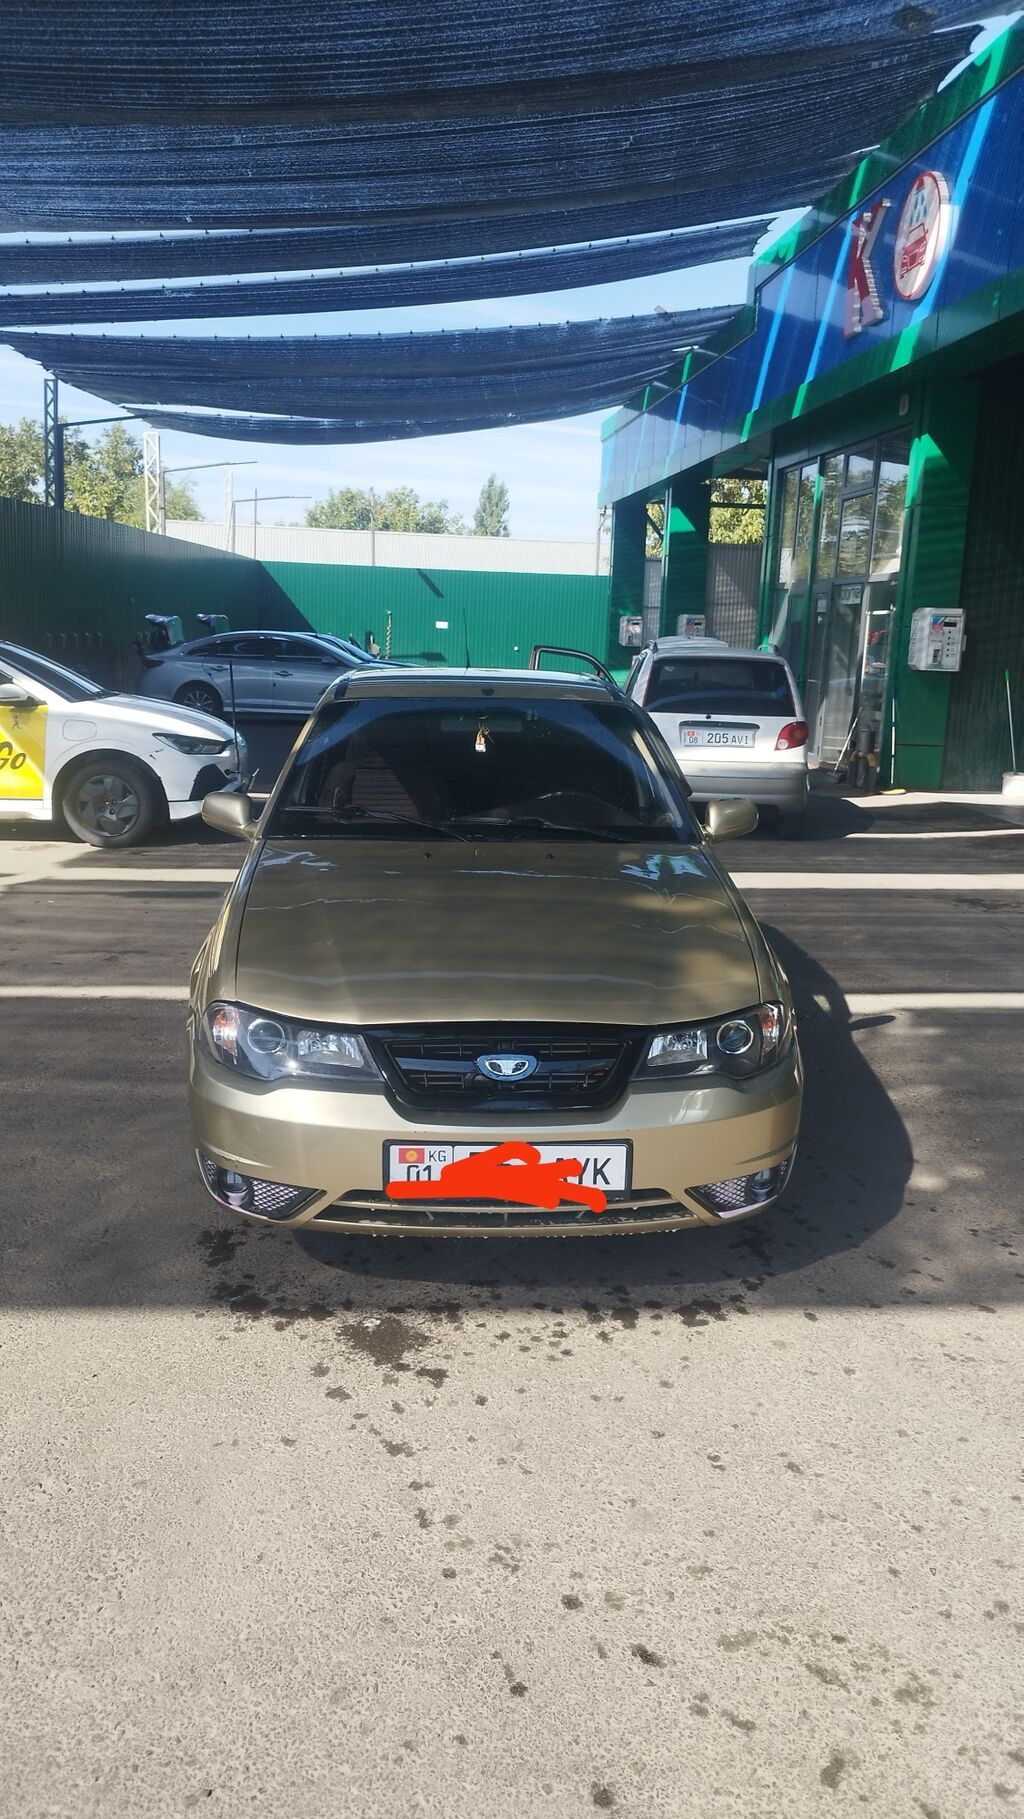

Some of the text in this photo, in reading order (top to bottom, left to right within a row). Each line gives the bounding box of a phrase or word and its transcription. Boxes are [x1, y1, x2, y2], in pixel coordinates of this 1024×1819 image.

[707, 732, 729, 744] 205
[428, 1150, 447, 1162] KG
[555, 1157, 612, 1185] YK
